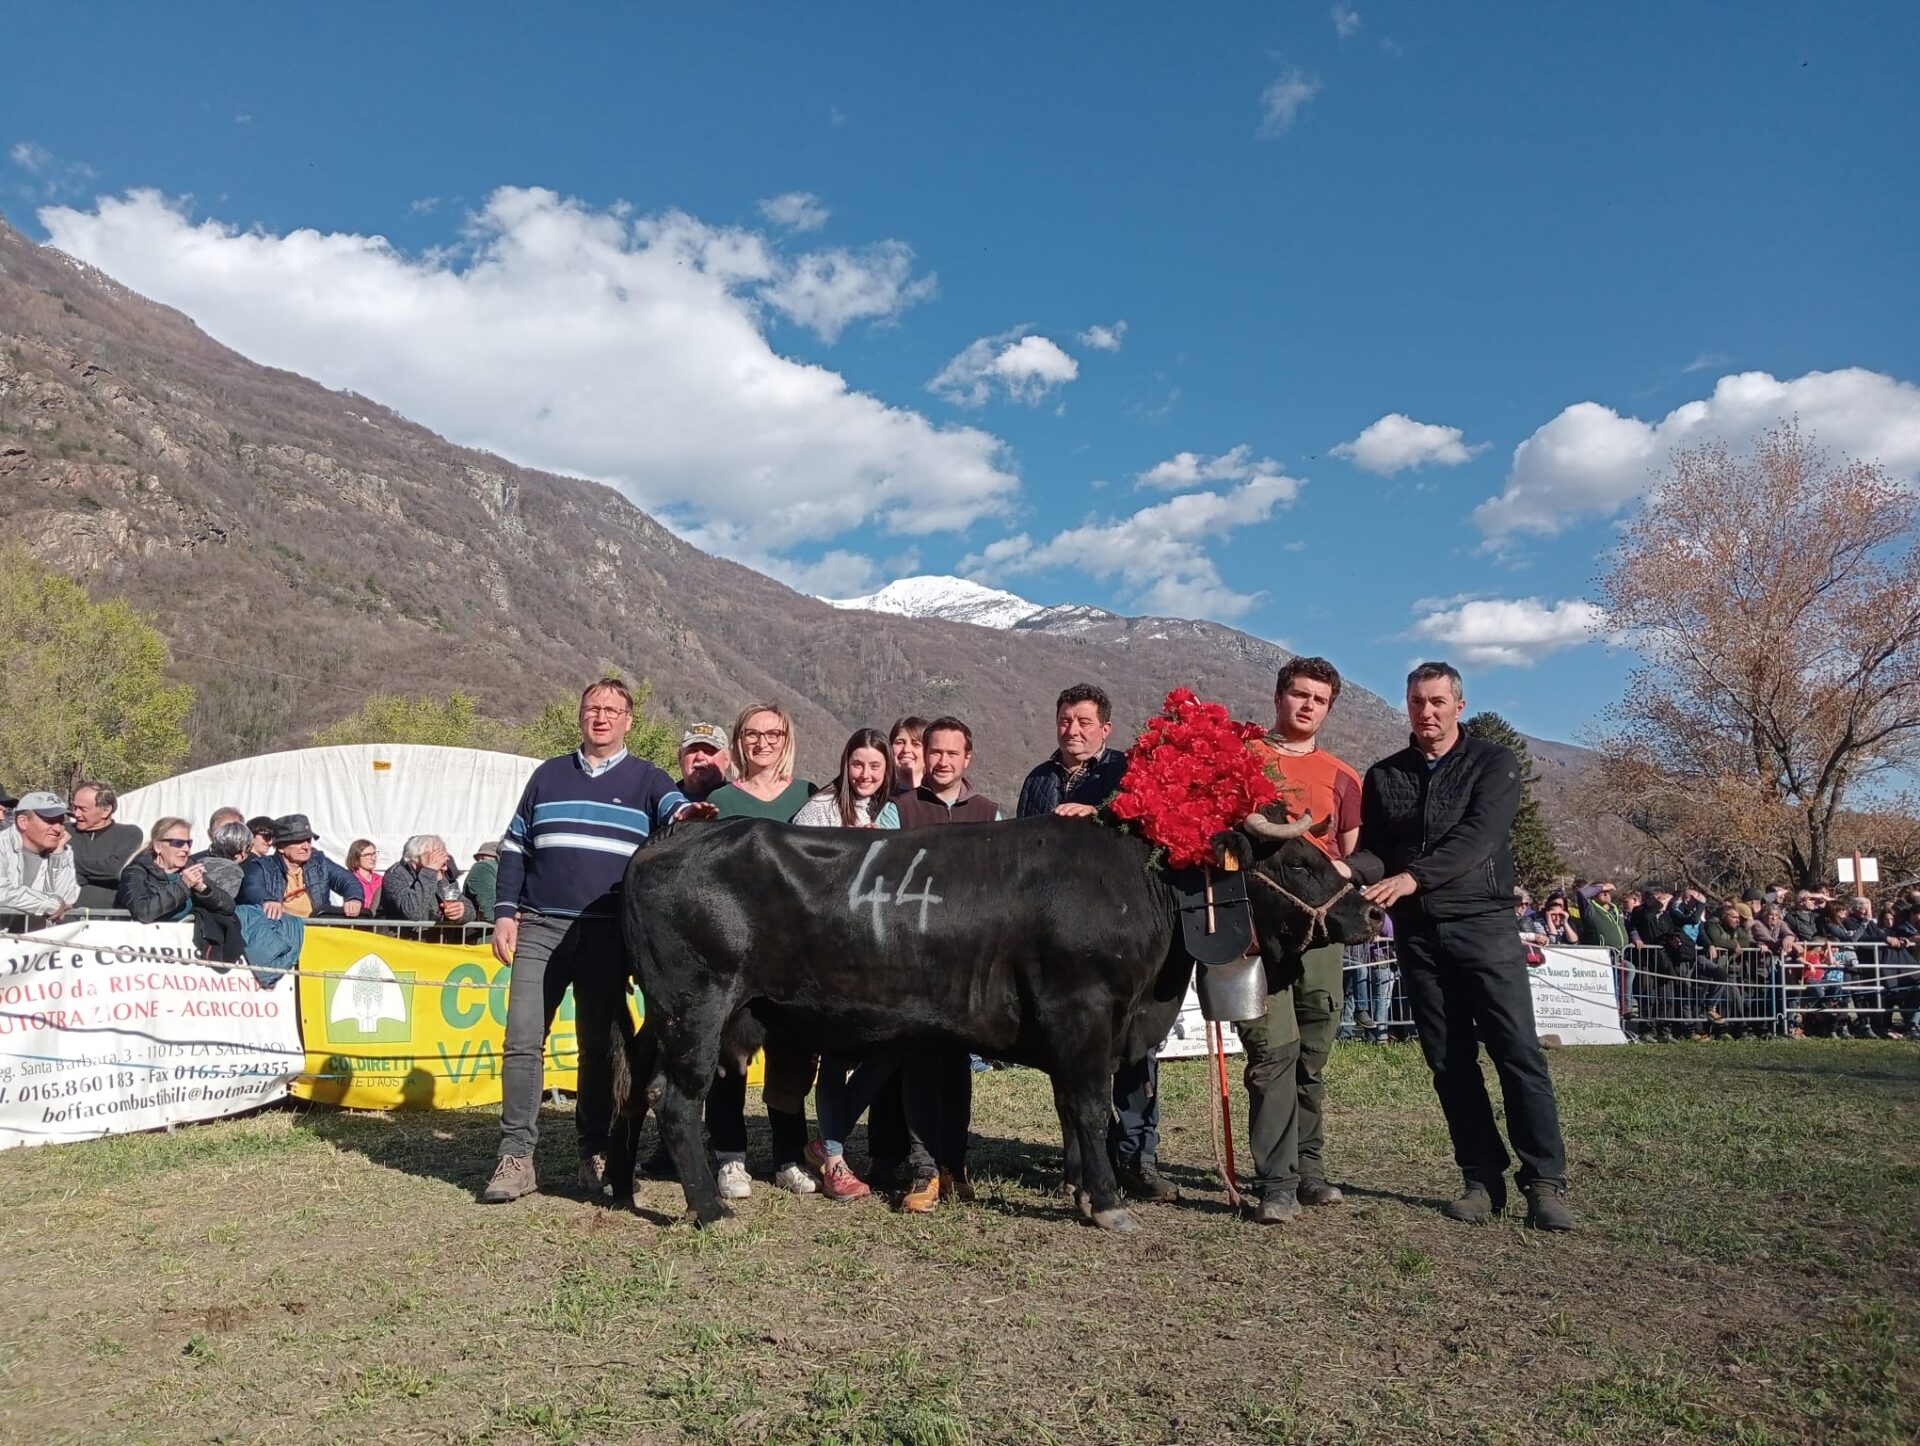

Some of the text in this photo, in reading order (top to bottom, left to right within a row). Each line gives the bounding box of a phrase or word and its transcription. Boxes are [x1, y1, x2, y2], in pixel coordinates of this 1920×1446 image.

[848, 839, 944, 945] 44
[71, 952, 84, 969] e
[1547, 966, 1570, 978] BIANCO
[1572, 967, 1598, 978] SERVIZI
[71, 979, 98, 999] da
[109, 972, 276, 994] RISCALDAMENT
[180, 1000, 280, 1018] AGRICOLO
[1536, 1006, 1549, 1016] +39
[20, 1061, 53, 1077] Santa
[124, 1048, 132, 1063] 3
[147, 1043, 185, 1060] 11015
[190, 1042, 211, 1057] LA
[215, 1042, 257, 1056] SALLE
[328, 1055, 415, 1073] COLDIRETTI
[149, 1068, 169, 1084] Fax
[174, 1061, 290, 1080] 0165.524355
